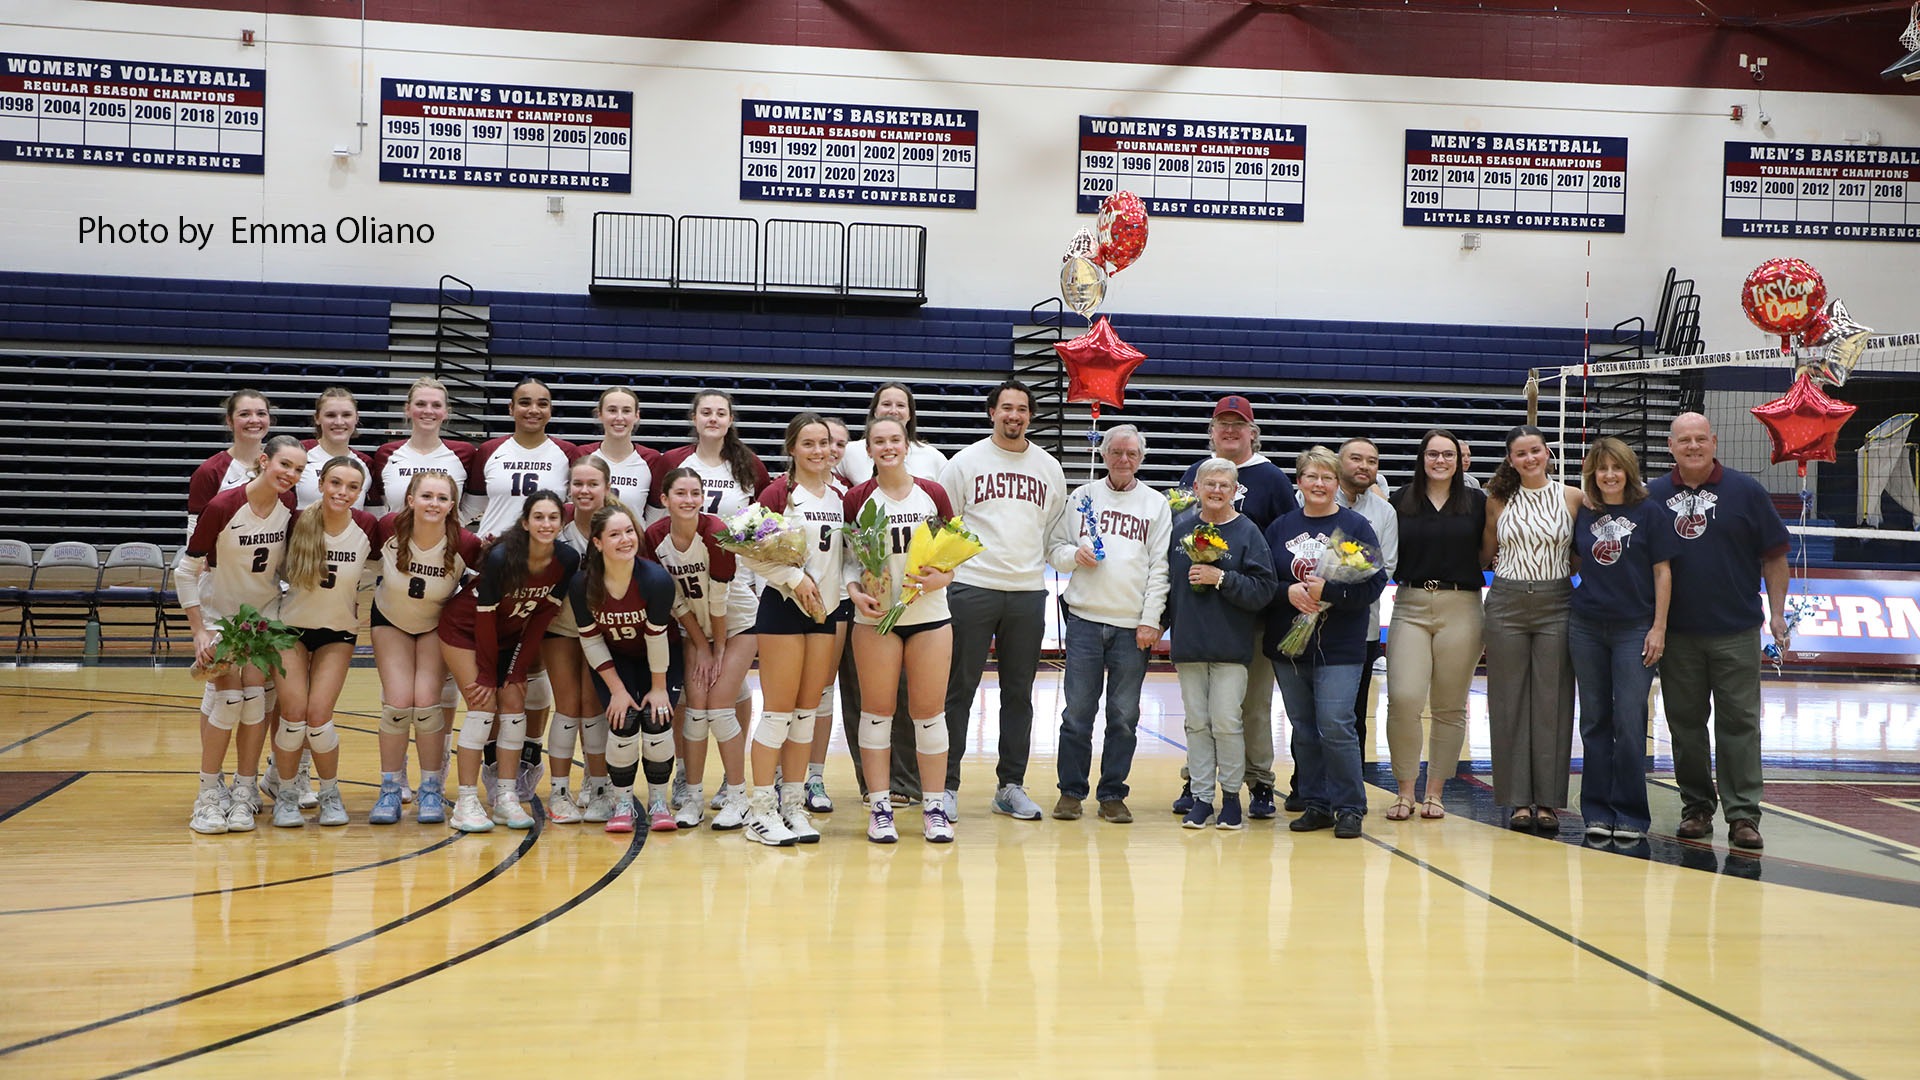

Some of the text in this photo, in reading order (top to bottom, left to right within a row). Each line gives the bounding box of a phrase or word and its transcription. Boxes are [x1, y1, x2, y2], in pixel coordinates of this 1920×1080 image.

[7, 58, 250, 87] WOMEN'S VOLLEYBALL
[24, 81, 235, 103] REGULAR SEASON CHAMPIONS
[396, 83, 618, 109] WOMEN'S VOLLEYBALL
[0, 96, 258, 125] 1998 2004 2005 2006 2018 2019
[423, 105, 592, 123] TOURNAMENT CHAMPIONS
[754, 104, 966, 127] WOMEN'S BASKETBALL
[387, 121, 626, 145] 1995 1996 1997 1998 2005 2006
[769, 125, 951, 141] REGULAR SEASON CHAMPIONS
[1091, 120, 1295, 142] WOMEN'S BASKETBALL
[387, 145, 461, 161] 2007 2018
[748, 141, 971, 162] 1991 1992 2001 2002 2009 2015
[1117, 141, 1269, 155] TOURNAMENT CHAMPIONS
[1431, 135, 1602, 154] MEN'S BASKETBALL
[16, 146, 241, 168] LITTLE EAST CONFERENCE
[1431, 154, 1602, 168] REGULAR SEASON CHAMPIONS
[1750, 147, 1920, 164] MEN'S BASKETBALL
[747, 164, 895, 182] 2016 2017 2020 2023
[1085, 156, 1299, 176] 1992 1996 2008 2015 2016 2019
[1760, 166, 1909, 178] TOURNAMENT CHAMPIONS
[403, 168, 609, 187] LITTLE EAST CONFERENCE
[1083, 178, 1113, 191] 2020
[1411, 169, 1621, 188] 2012 2014 2015 2016 2017 2018
[762, 186, 956, 203] LITTLE EAST CONFERENCE
[1411, 191, 1439, 204] 2019
[1730, 181, 1902, 197] 1992 2000 2012 2017 2018
[1153, 202, 1187, 212] EAST
[1194, 205, 1284, 216] CONFERENCE
[1424, 213, 1606, 227] LITTLE EAST CONFERENCE
[1743, 223, 1789, 233] LITTLE
[1795, 225, 1829, 234] EAST
[1889, 334, 1920, 347] WARRI
[1663, 353, 1730, 367] EASTERN WARRIORS
[1746, 348, 1780, 360] EASTERN
[1592, 360, 1650, 373] EASTERN WARRIORS
[503, 462, 552, 471] WARRIORS
[511, 473, 538, 496] 16
[611, 476, 637, 486] RIORS
[702, 480, 734, 488] RRIORS
[975, 473, 1047, 510] EASTERN
[803, 512, 842, 522] WARRIORS
[1079, 510, 1149, 544] ESTERN
[239, 531, 284, 545] WARRIORS
[819, 525, 832, 552] 9
[891, 527, 911, 553] 11
[252, 547, 269, 572] 2
[328, 551, 356, 562] RIORS
[320, 565, 337, 589] 5
[410, 562, 445, 577] RRIORS
[408, 577, 426, 599] 8
[505, 584, 556, 598] ASTER
[678, 576, 703, 599] 15
[509, 600, 537, 618] 12
[609, 627, 637, 640] 19
